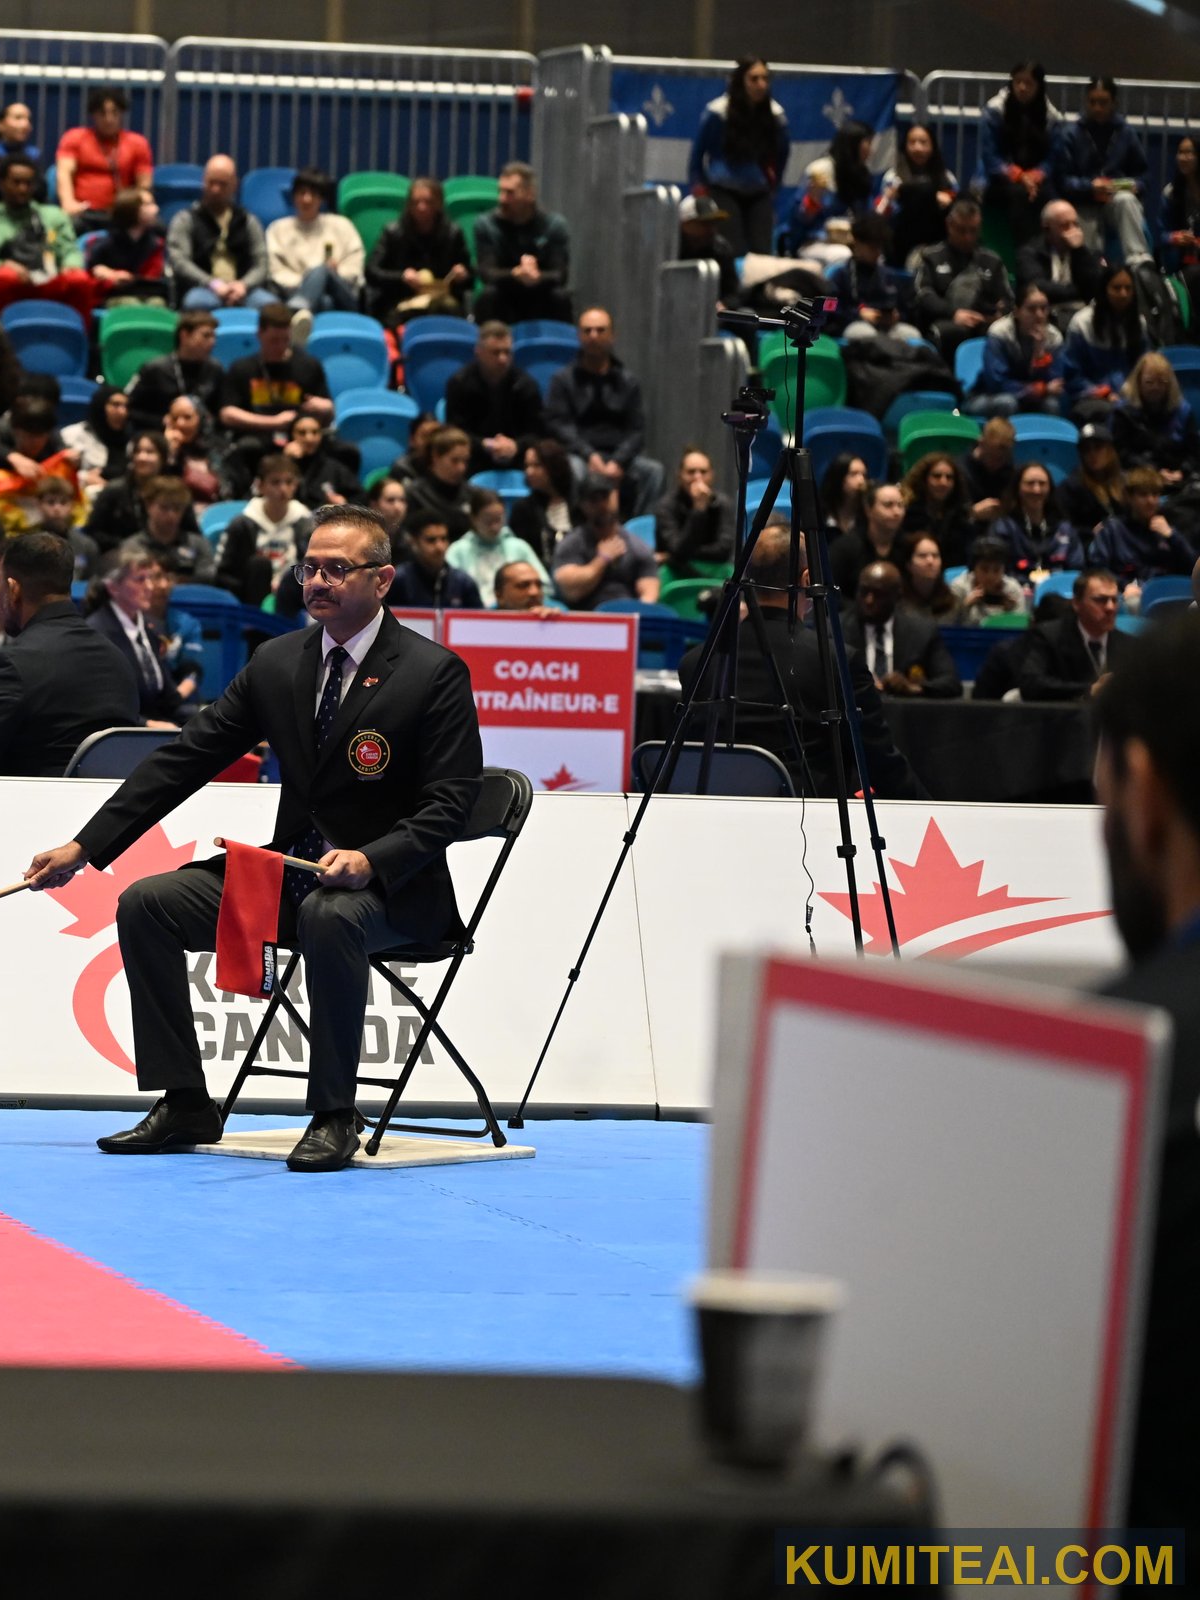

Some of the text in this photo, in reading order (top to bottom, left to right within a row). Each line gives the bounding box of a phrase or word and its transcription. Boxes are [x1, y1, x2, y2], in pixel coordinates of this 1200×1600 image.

[493, 660, 580, 681] COACH
[472, 687, 620, 713] TRAÎNEUR·E
[193, 1012, 435, 1065] CANDA
